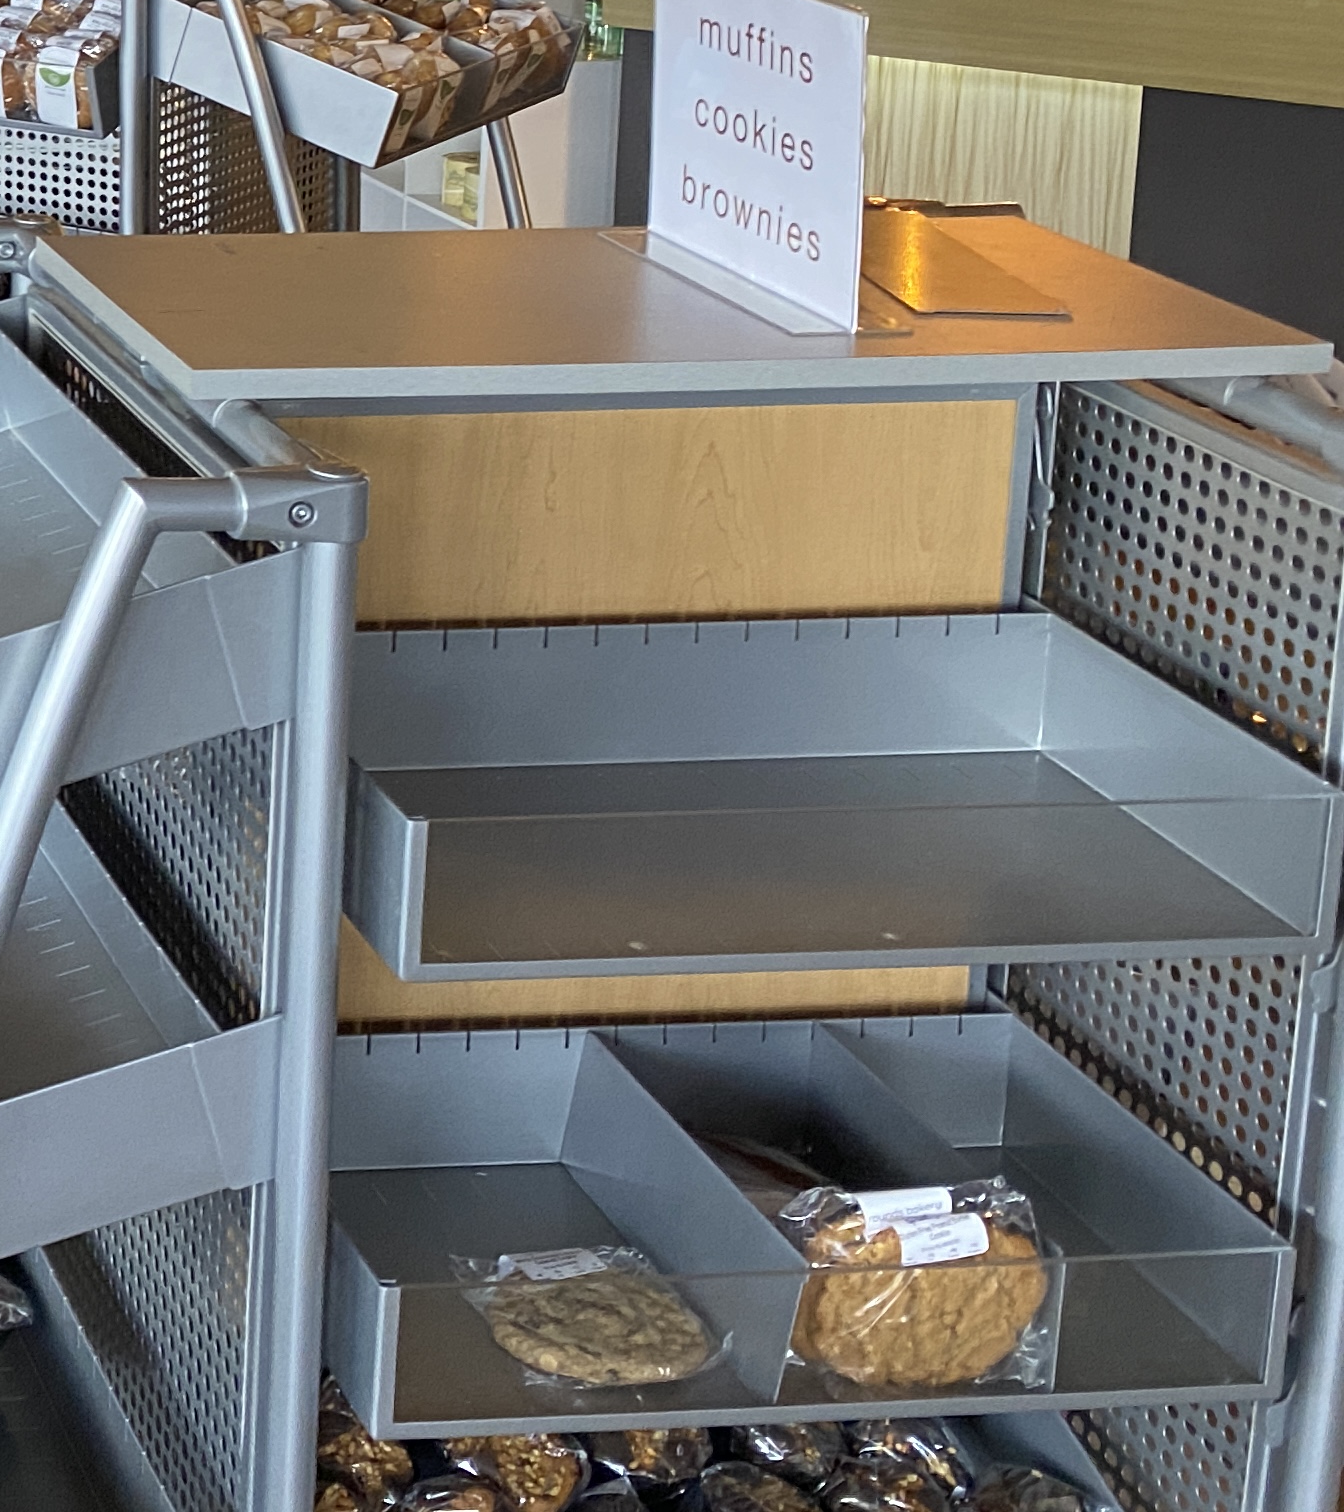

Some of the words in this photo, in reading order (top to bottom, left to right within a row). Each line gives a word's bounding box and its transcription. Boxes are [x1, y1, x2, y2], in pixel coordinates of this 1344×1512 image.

[699, 17, 813, 83] muffins
[695, 98, 813, 171] cookies
[681, 163, 821, 261] brownies
